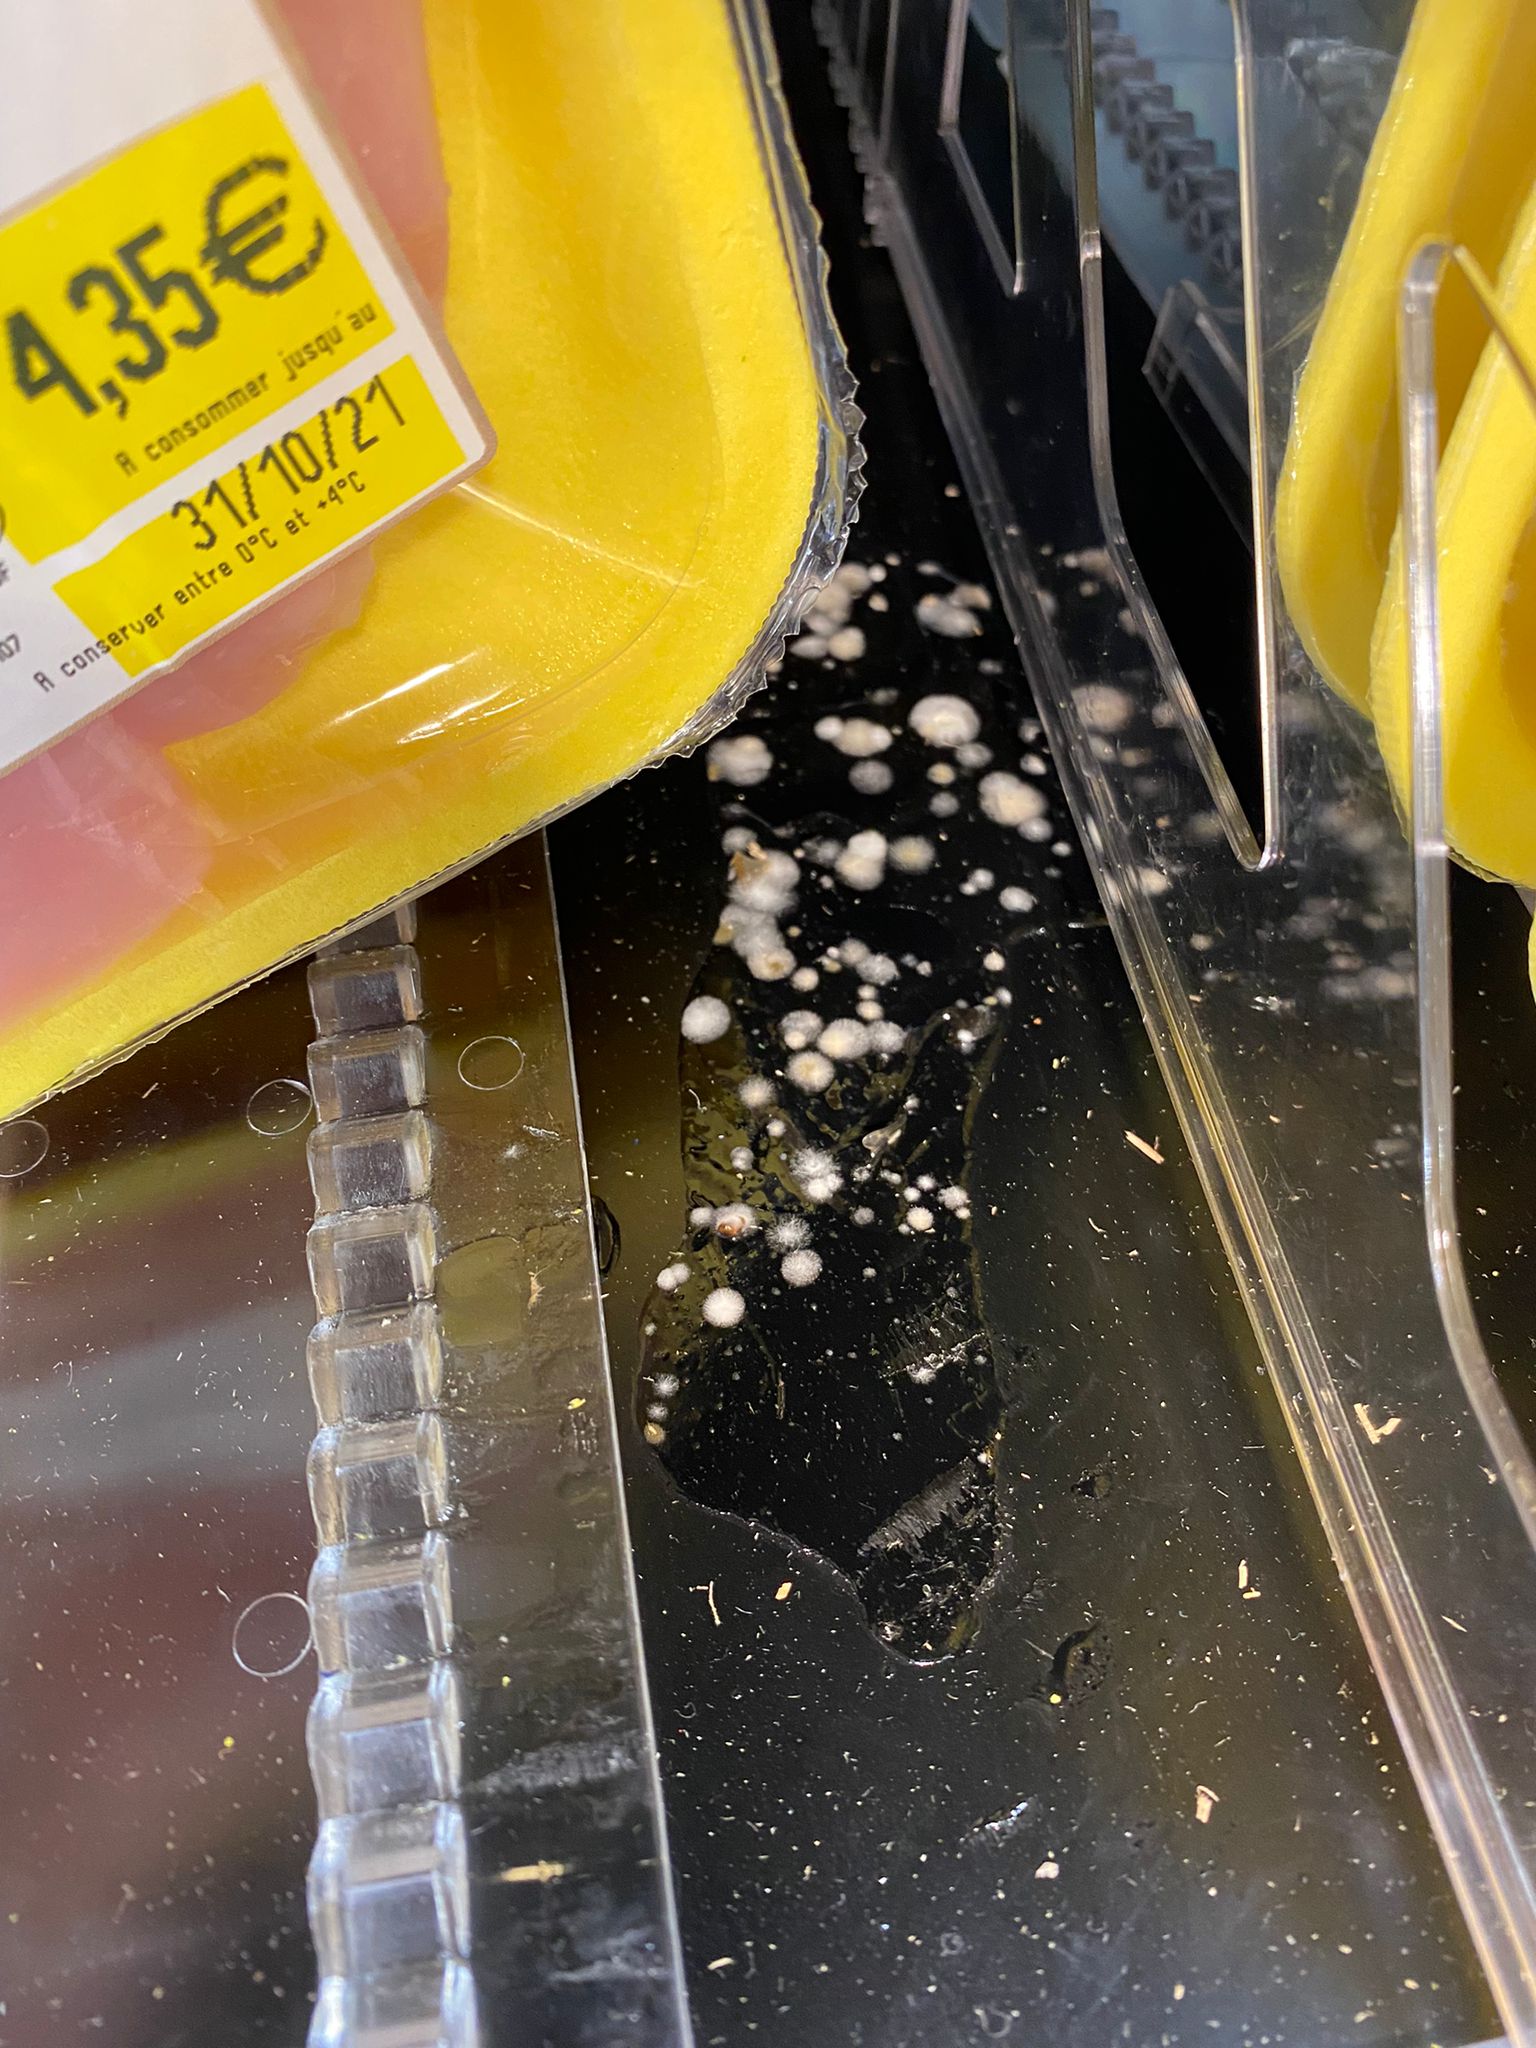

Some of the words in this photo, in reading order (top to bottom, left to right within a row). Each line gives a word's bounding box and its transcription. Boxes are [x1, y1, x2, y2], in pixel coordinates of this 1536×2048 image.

[6, 156, 327, 420] 4,35€
[144, 372, 270, 462] consommer
[171, 374, 405, 550] 31/10/21
[60, 602, 166, 678] conserver
[173, 560, 233, 606] entre
[235, 527, 278, 564] 0°C
[285, 508, 310, 536] et
[317, 470, 366, 510] +4°C
